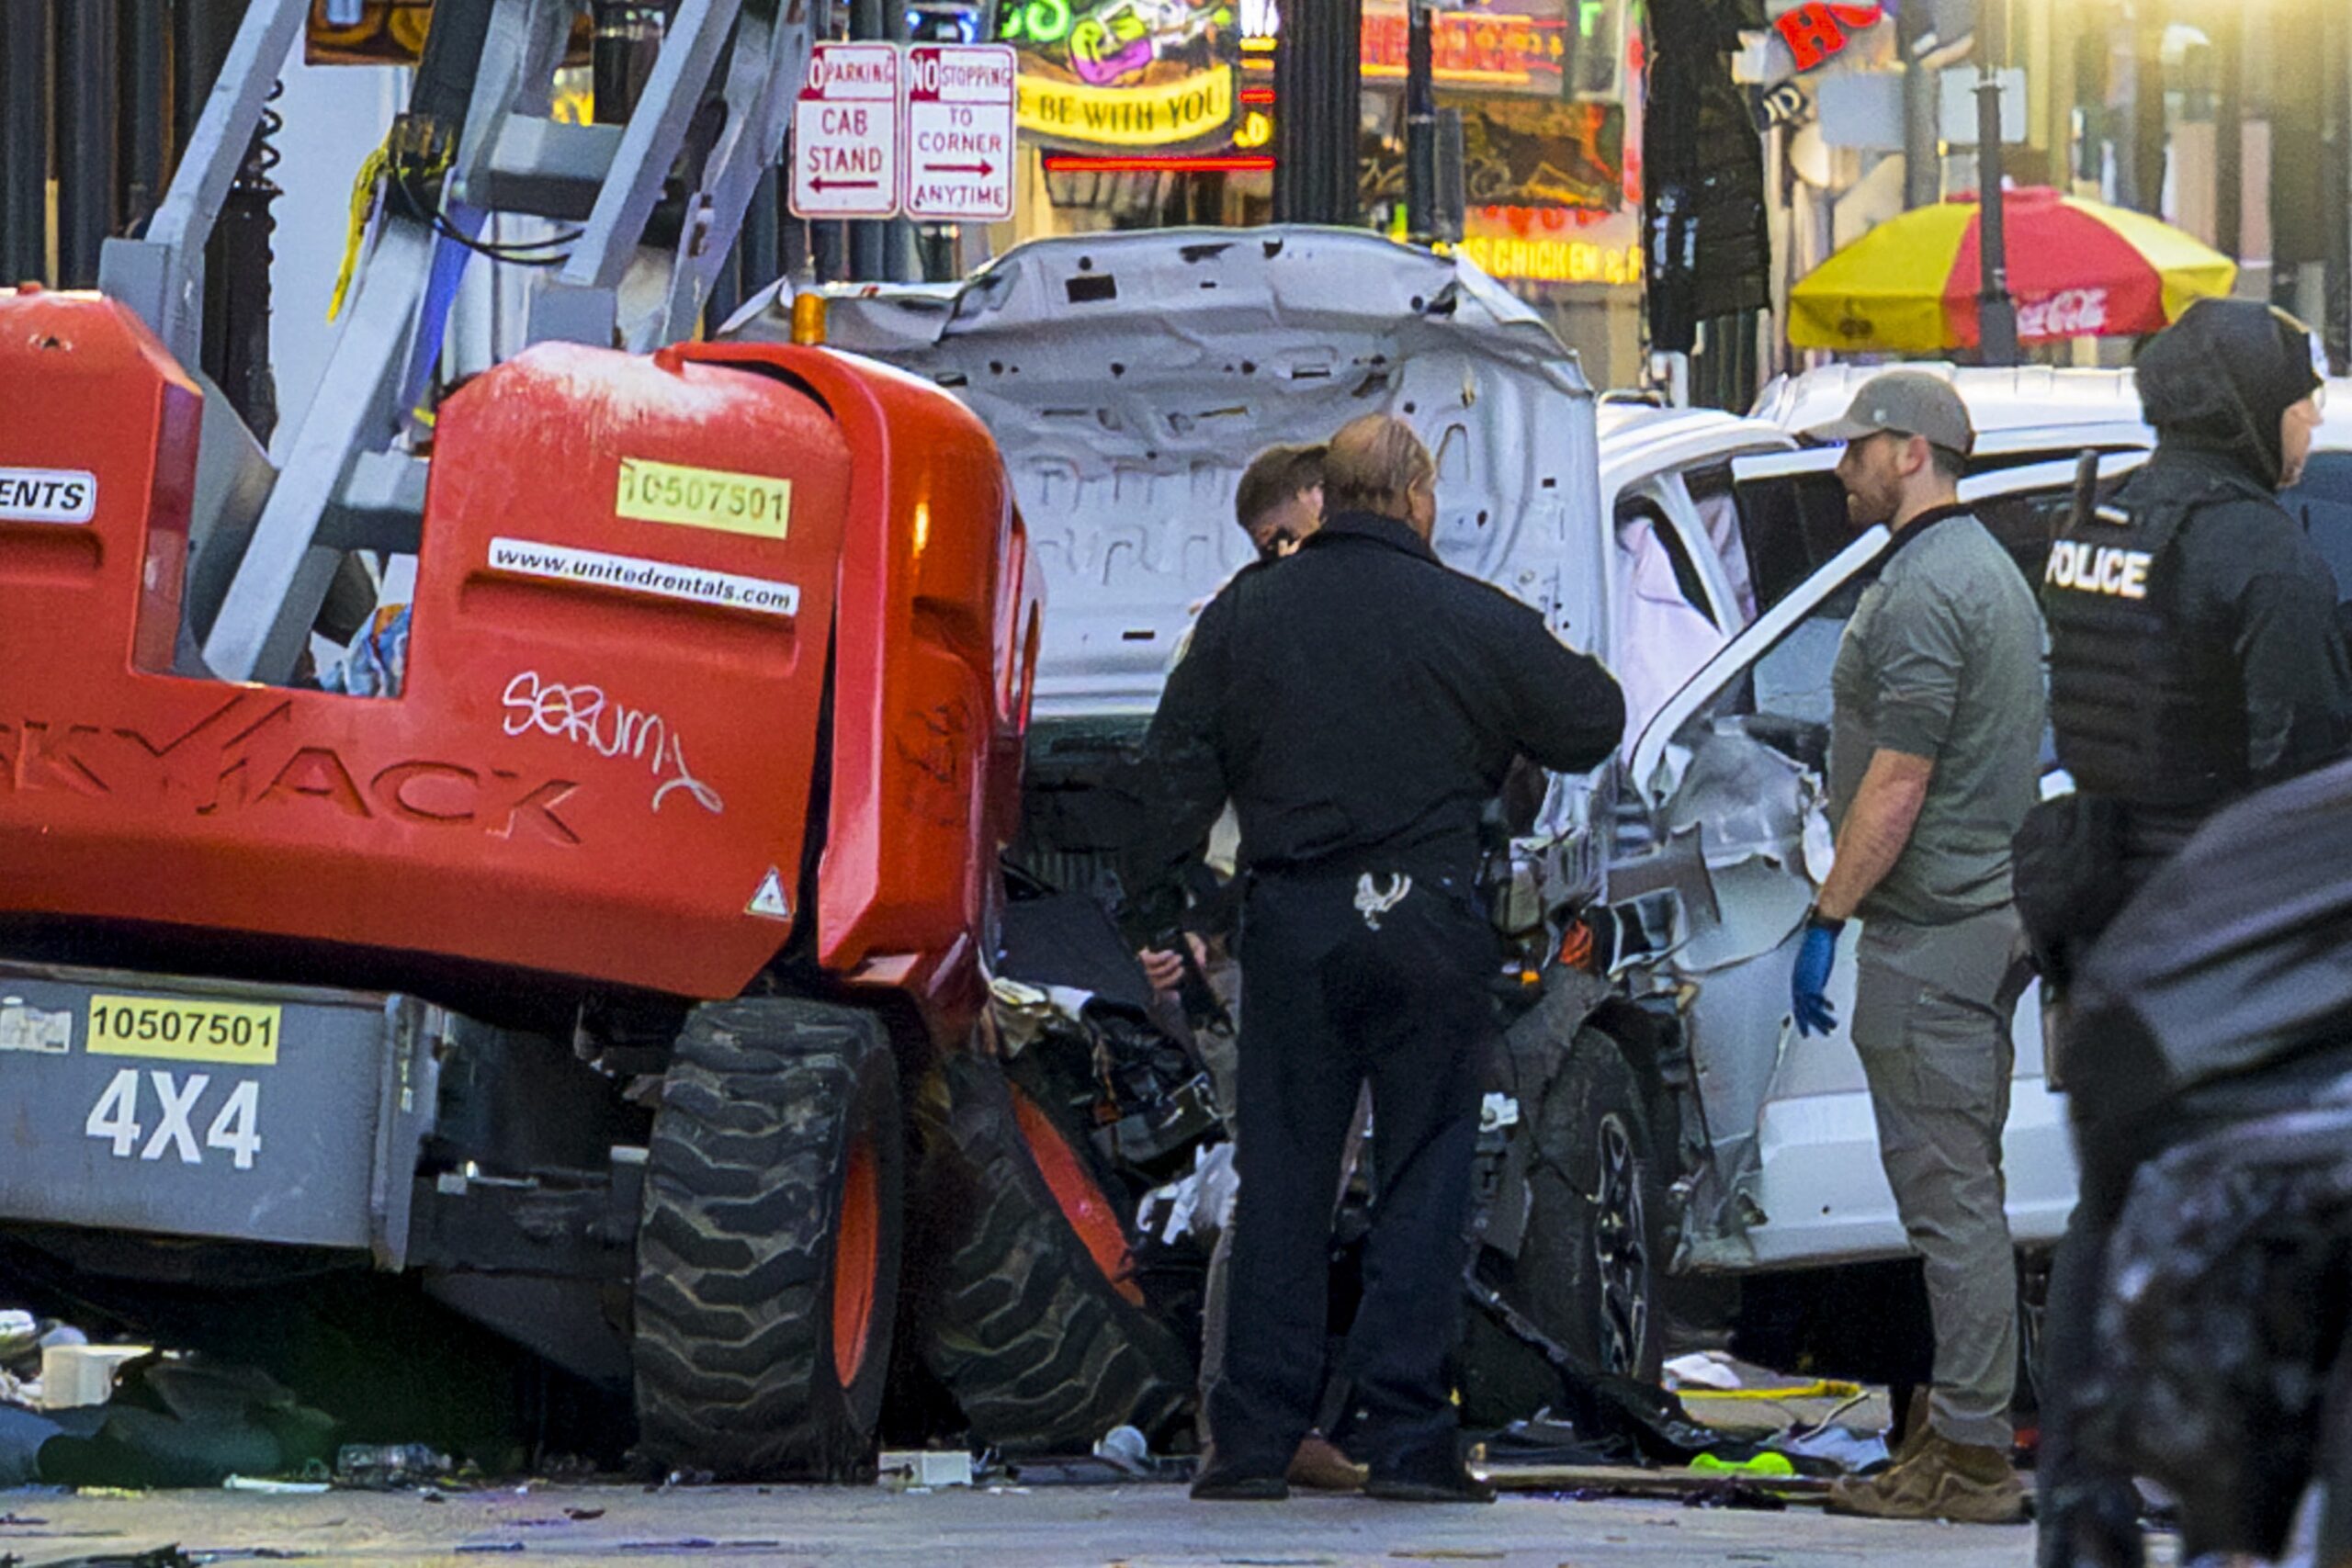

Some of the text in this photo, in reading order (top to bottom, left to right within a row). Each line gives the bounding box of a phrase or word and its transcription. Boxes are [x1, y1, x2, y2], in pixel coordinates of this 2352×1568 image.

[804, 56, 894, 90] O PARKING
[910, 53, 1011, 93] NO STOPPING
[821, 108, 867, 137] CAB
[948, 107, 973, 127] TO
[1038, 94, 1075, 124] BE
[1082, 101, 1154, 132] WITH
[1168, 84, 1225, 130] YOU
[807, 145, 883, 174] STAND
[918, 132, 1001, 153] CORNER
[917, 184, 1004, 208] ANYTIME
[1492, 238, 1600, 280] CHICKEN
[623, 471, 784, 522] 10507501
[496, 548, 791, 610] www.unitedrentals.com
[0, 695, 582, 845] KYJACK
[92, 1007, 273, 1047] 10507501
[85, 1068, 262, 1170] 4X4
